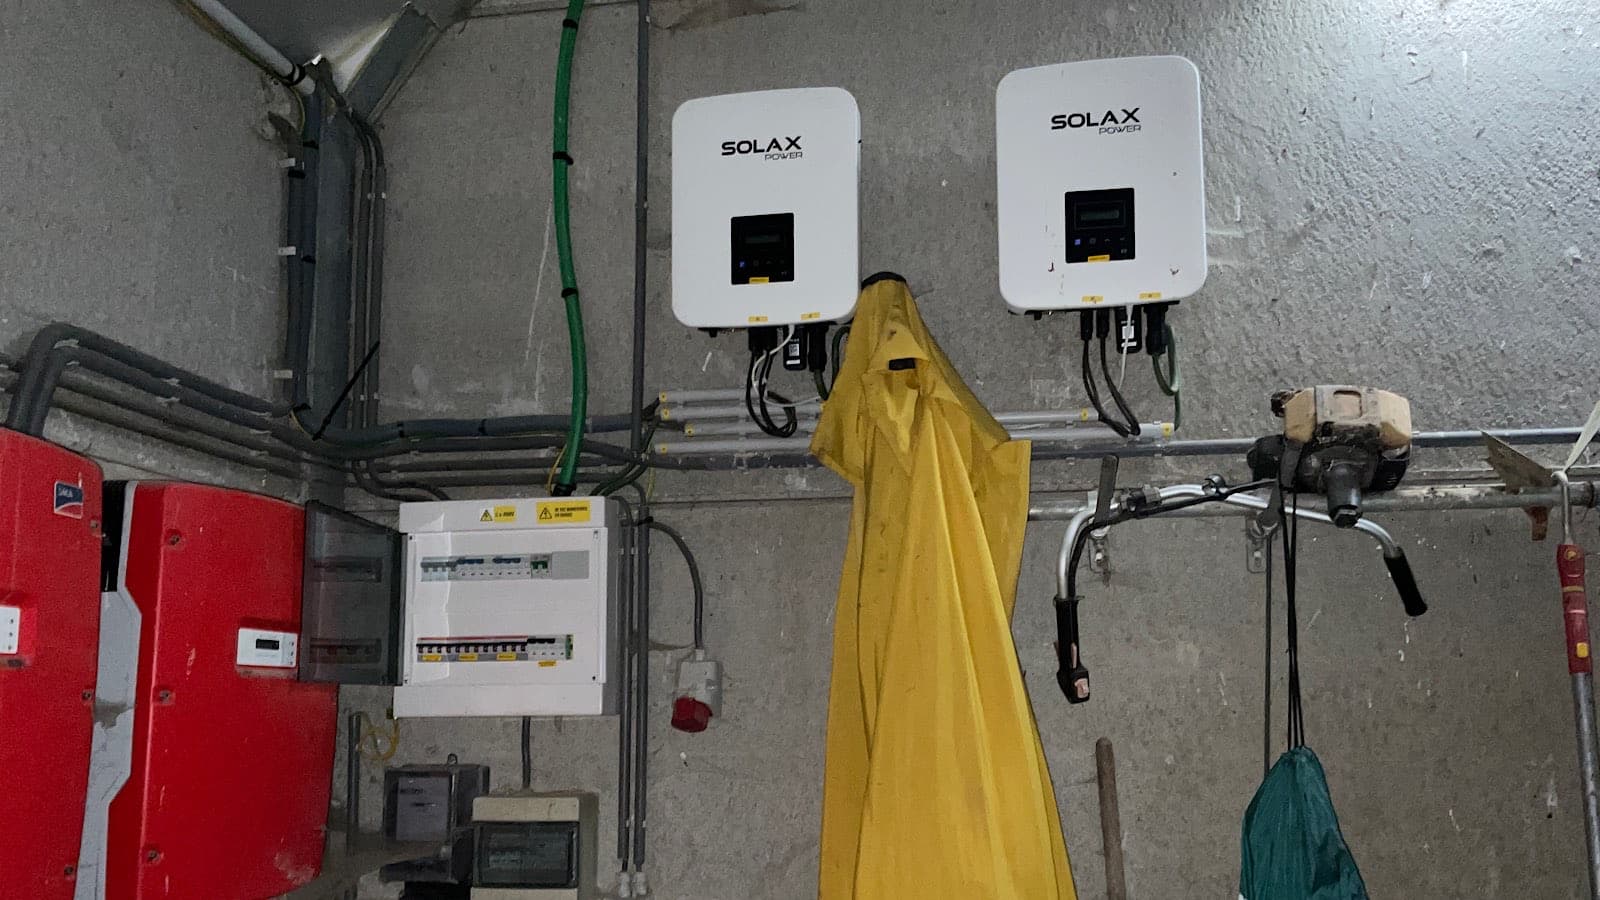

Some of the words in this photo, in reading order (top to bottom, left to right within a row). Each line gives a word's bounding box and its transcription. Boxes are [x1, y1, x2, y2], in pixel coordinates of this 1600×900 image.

[1051, 107, 1140, 130] SOLAX
[1099, 124, 1141, 135] POWER
[721, 135, 802, 156] SOLAX
[764, 151, 803, 161] POWER
